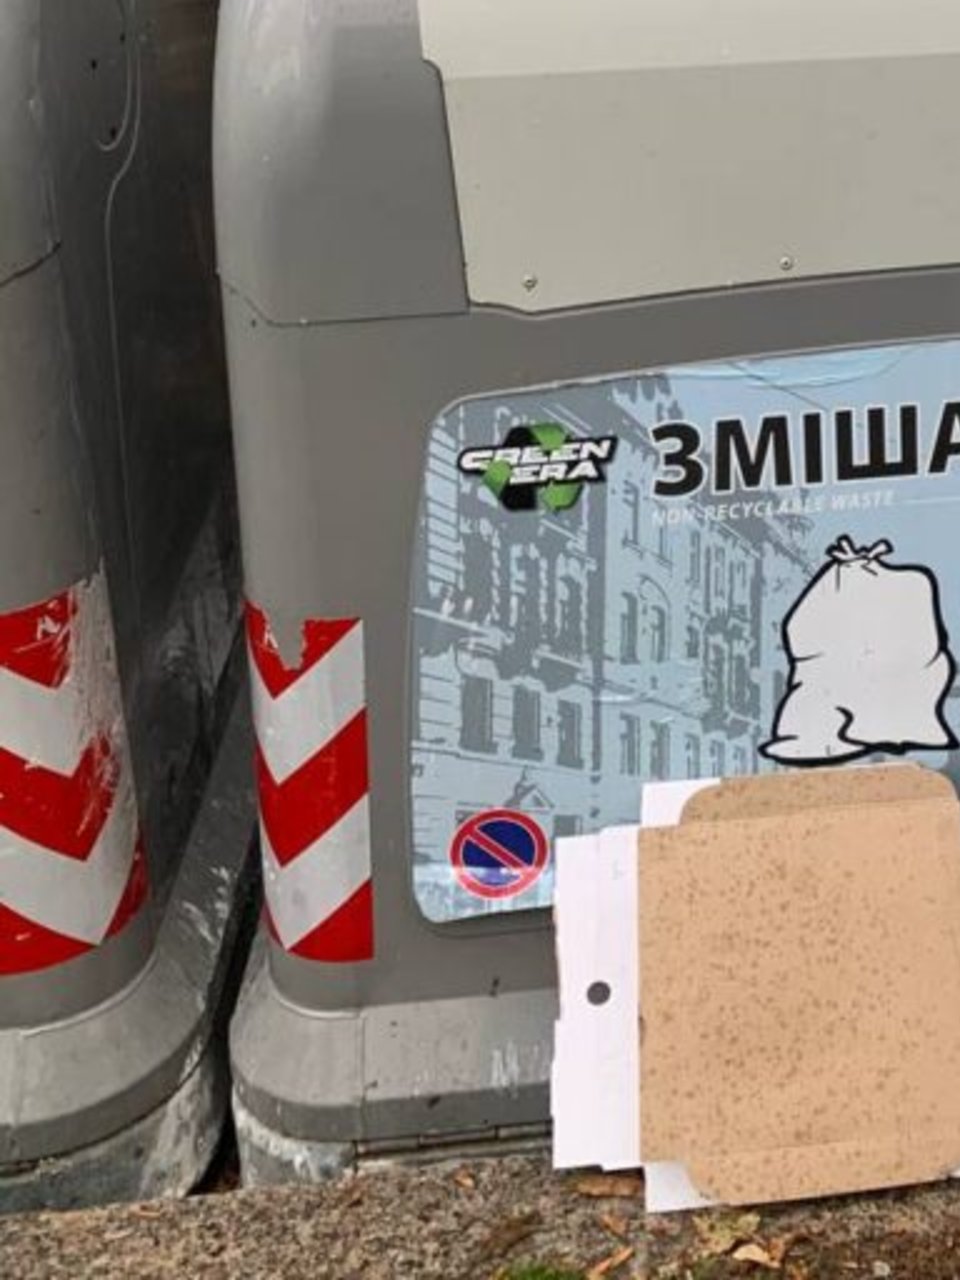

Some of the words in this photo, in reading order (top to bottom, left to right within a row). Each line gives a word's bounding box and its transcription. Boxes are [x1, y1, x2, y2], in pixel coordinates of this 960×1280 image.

[460, 439, 611, 470] GREEN
[509, 461, 599, 485] ERA
[831, 489, 895, 511] WASTE
